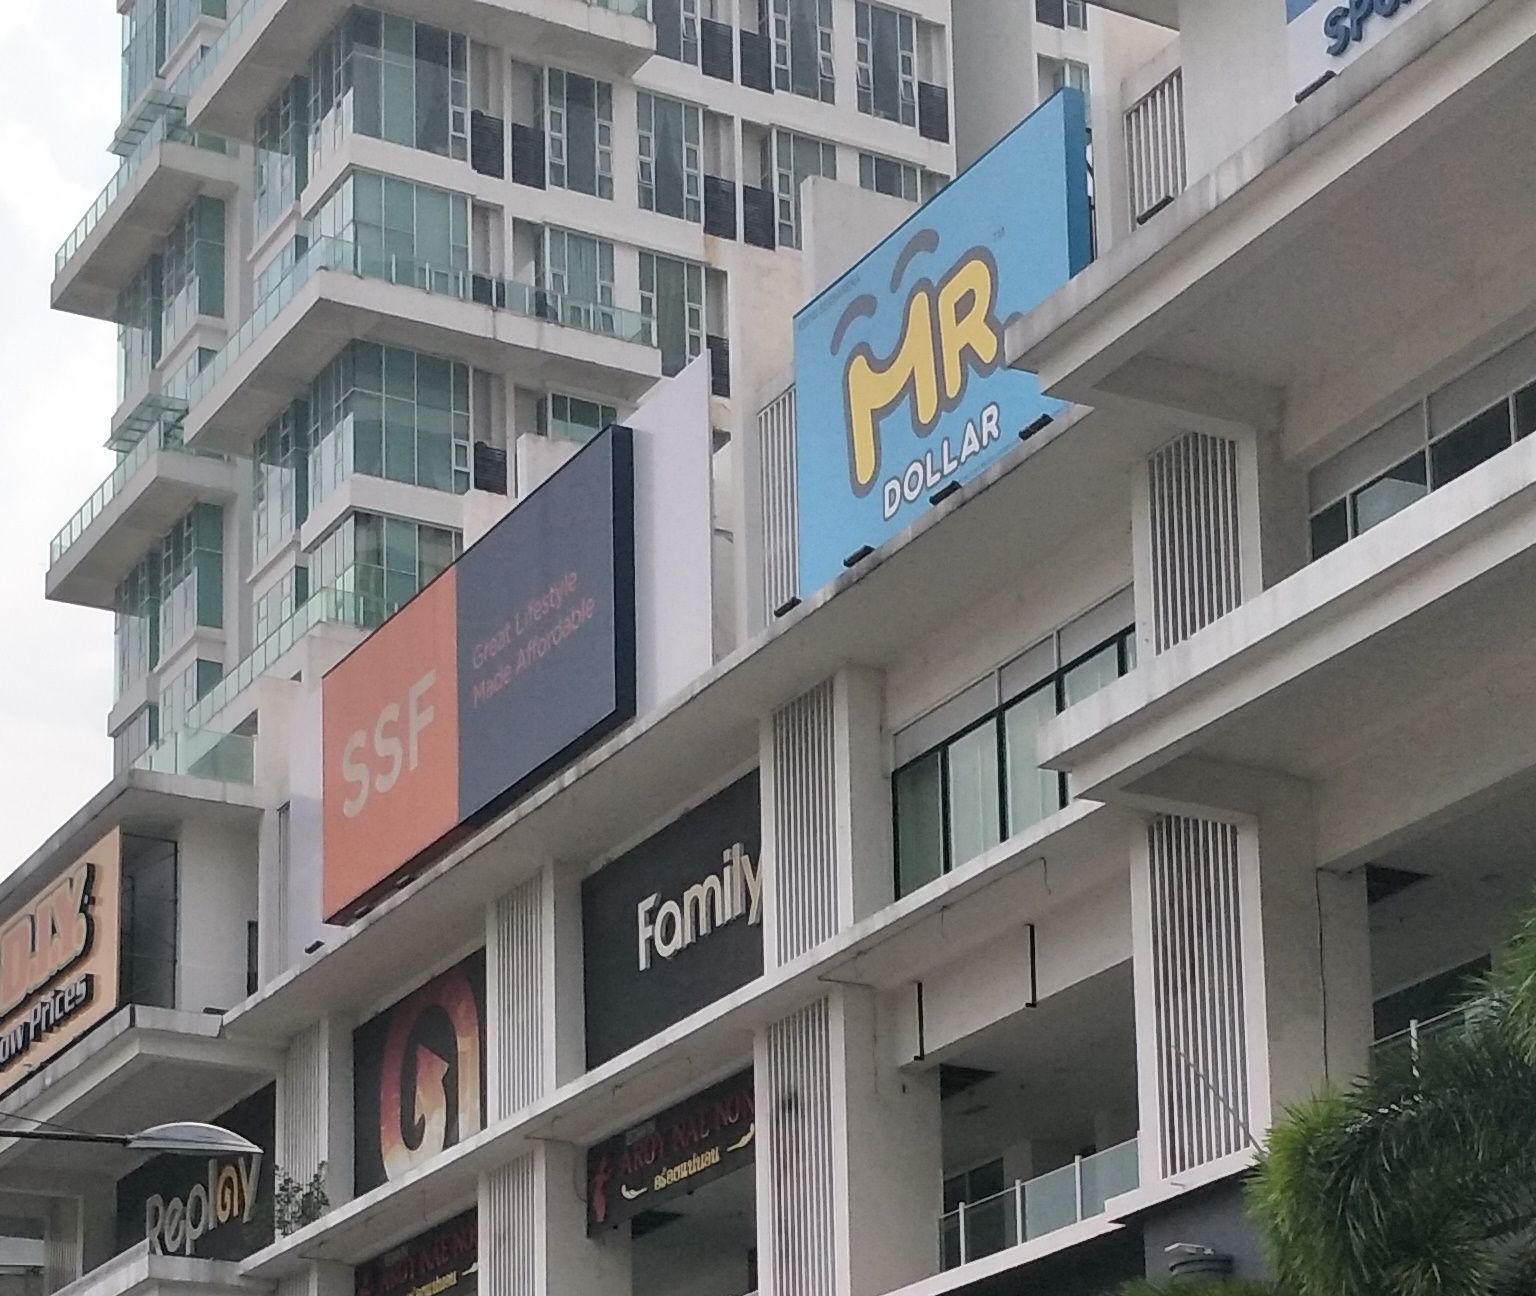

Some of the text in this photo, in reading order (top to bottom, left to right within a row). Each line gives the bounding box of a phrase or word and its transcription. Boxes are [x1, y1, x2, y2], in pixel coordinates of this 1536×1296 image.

[846, 252, 999, 490] MR
[882, 402, 1001, 521] DOLLAR
[472, 597, 595, 708] Made Affordable
[473, 623, 512, 669] Great
[341, 669, 439, 819] SSF
[637, 842, 763, 972] Family
[29, 973, 90, 1042] Prices
[145, 1153, 262, 1256] Replay
